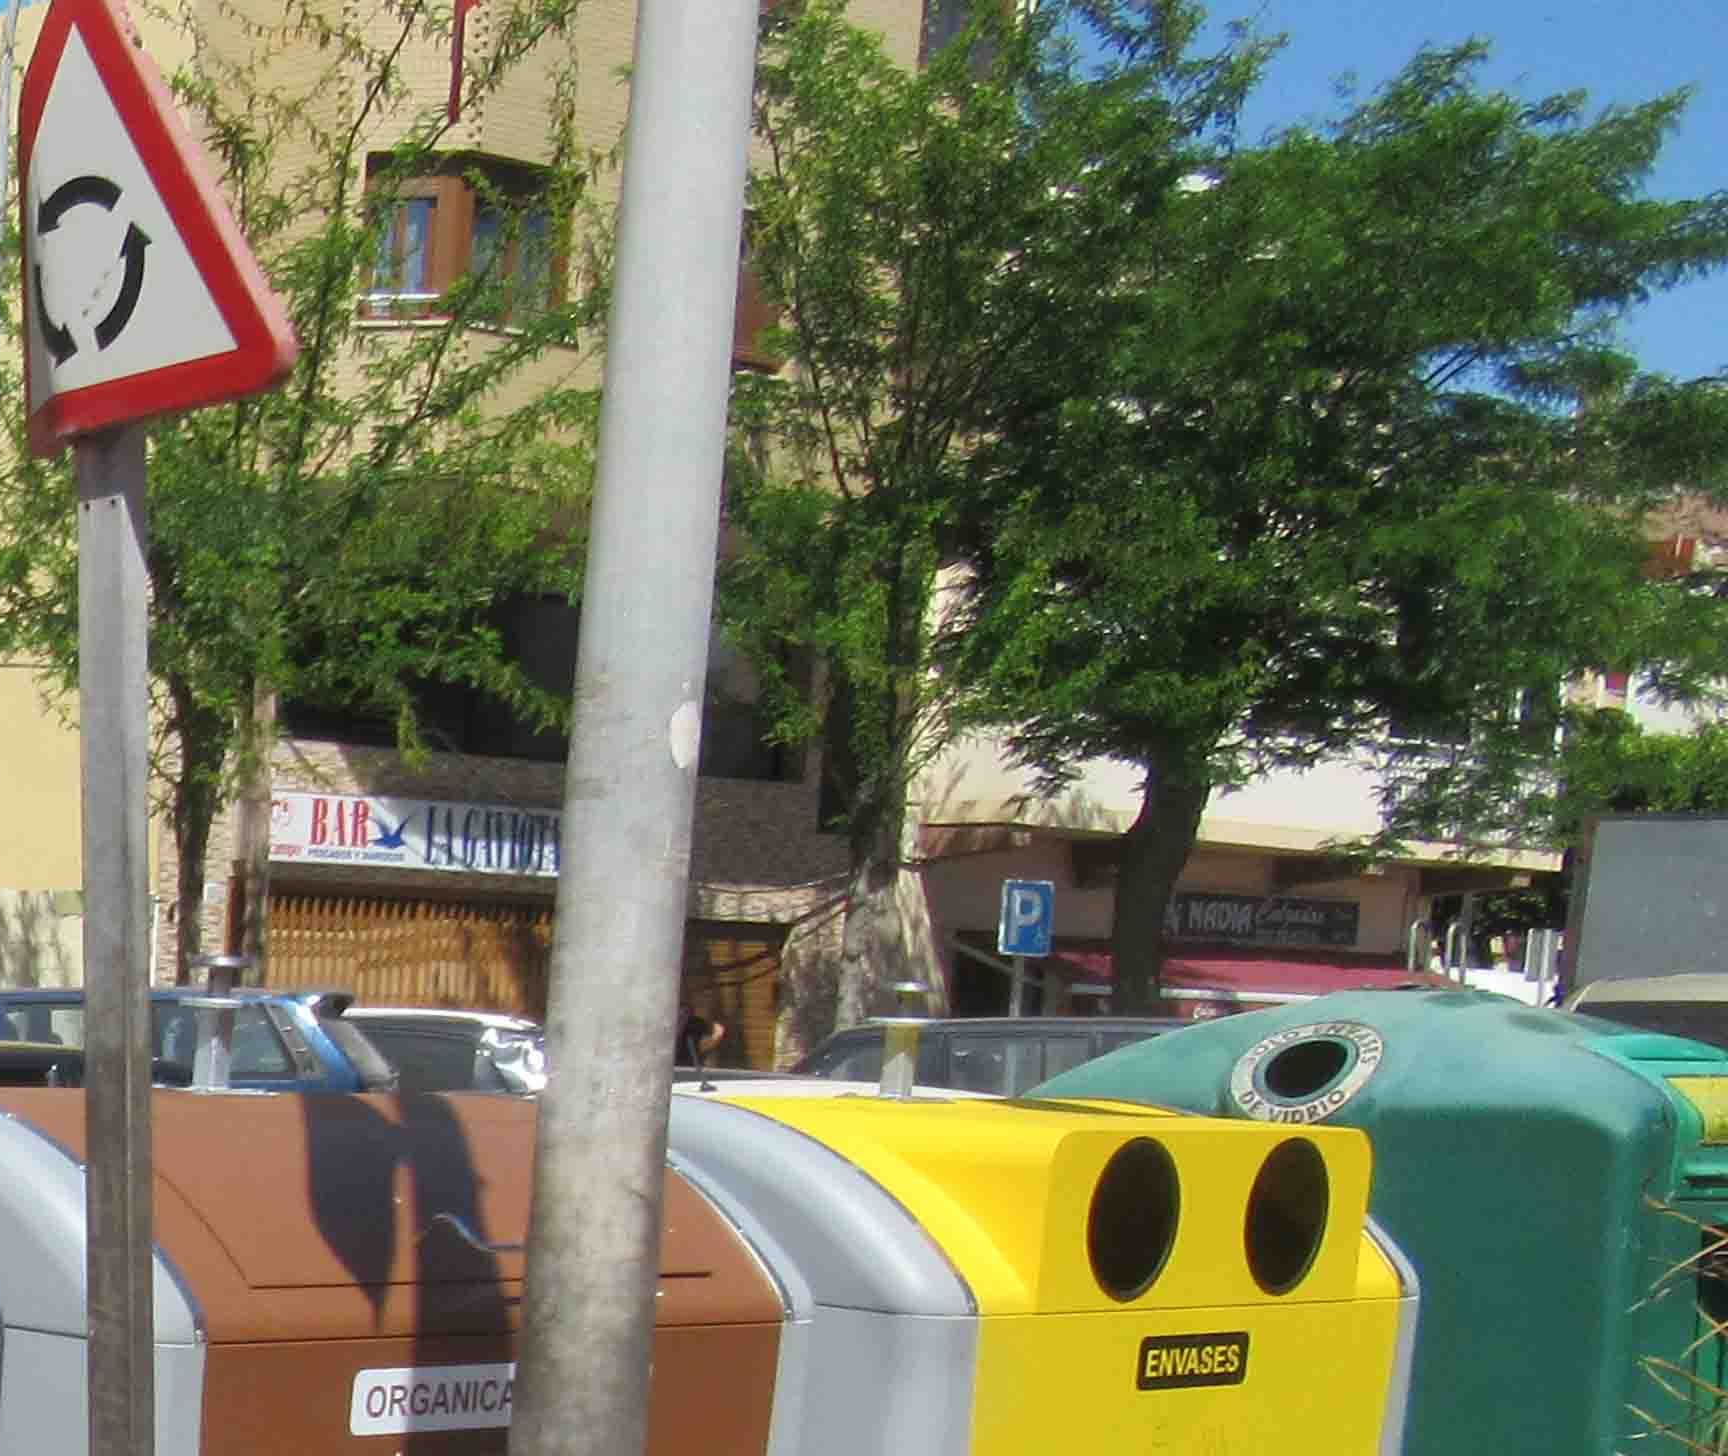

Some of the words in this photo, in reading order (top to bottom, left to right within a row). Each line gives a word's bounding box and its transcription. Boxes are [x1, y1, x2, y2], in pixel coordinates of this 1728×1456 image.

[310, 798, 370, 848] BAR
[1008, 890, 1041, 945] P
[1269, 1090, 1344, 1122] VIDRIO
[1145, 1344, 1239, 1378] ENVASES
[366, 1379, 512, 1418] ORGANICA
